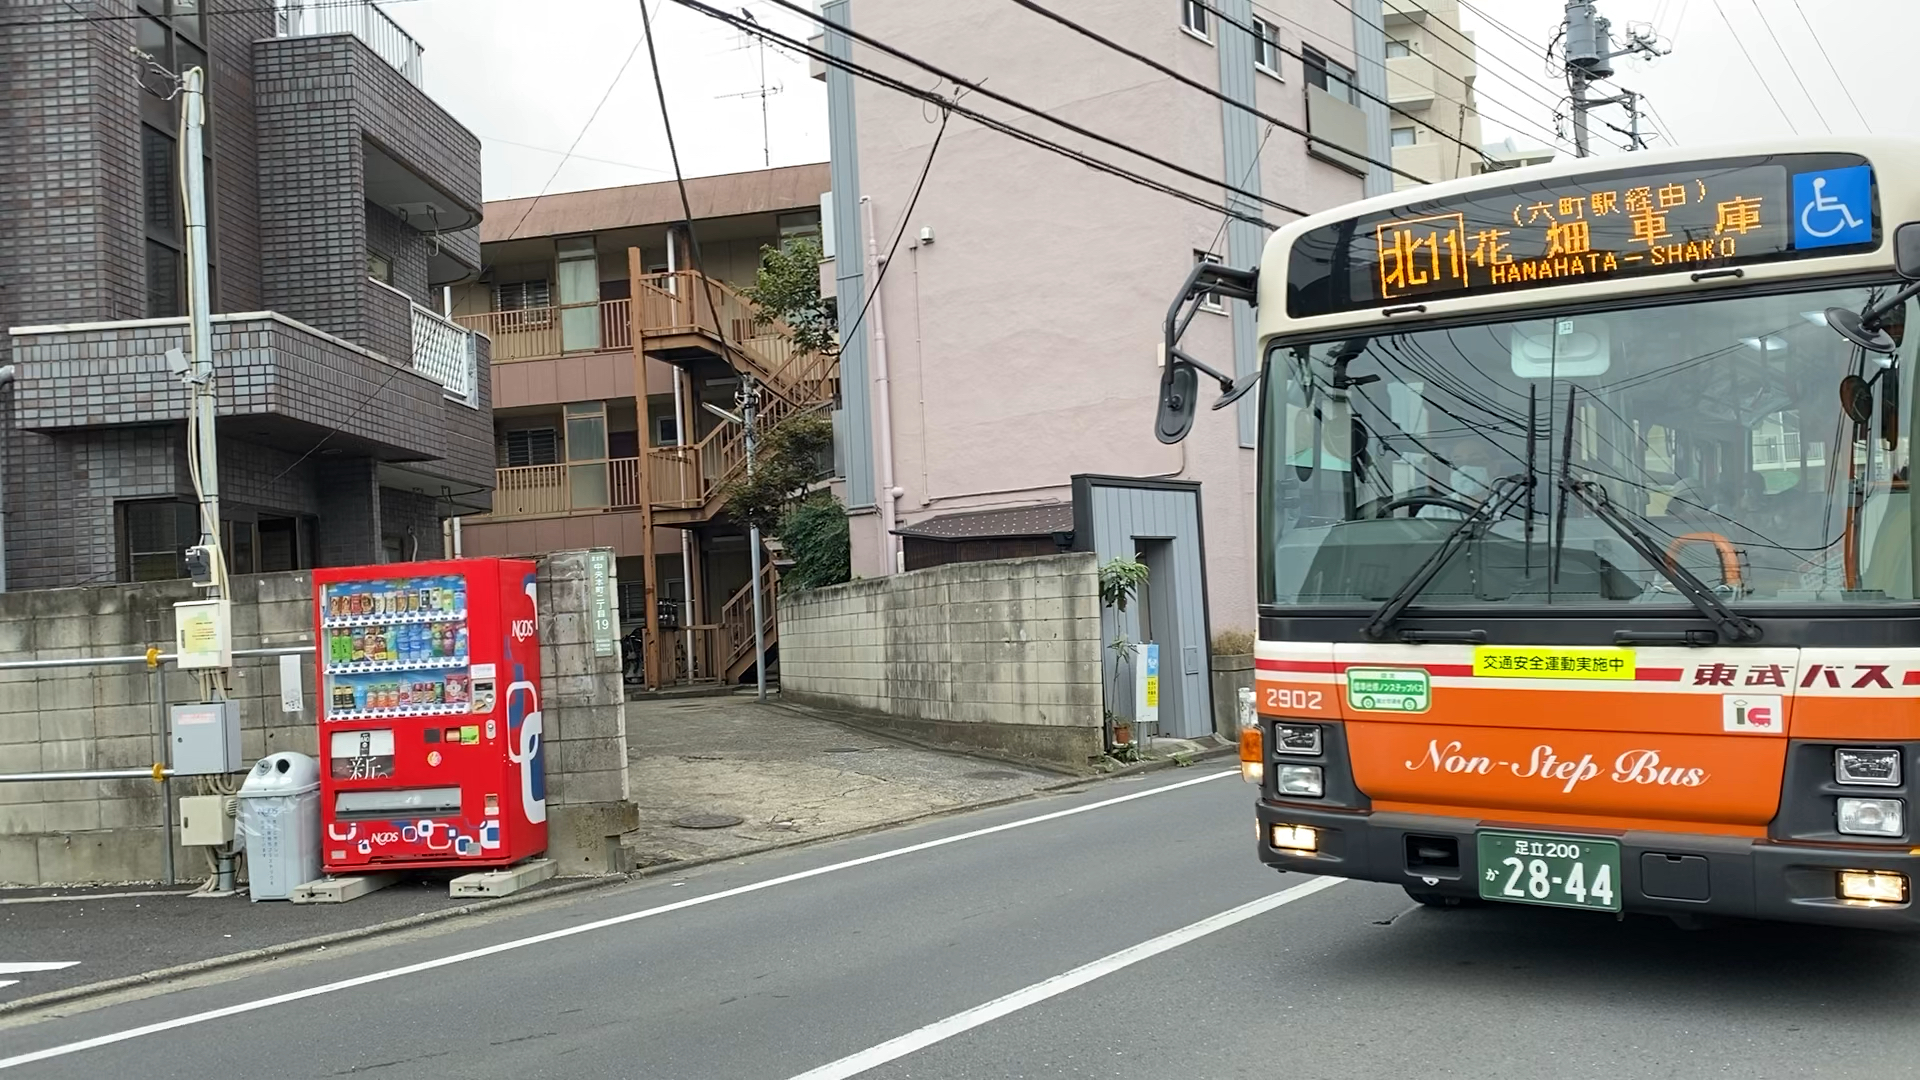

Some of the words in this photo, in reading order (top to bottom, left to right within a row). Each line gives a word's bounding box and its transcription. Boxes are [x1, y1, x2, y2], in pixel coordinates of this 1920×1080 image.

[1383, 227, 1460, 290] 北11
[595, 619, 609, 630] 19
[1483, 655, 1625, 673] 交通安全運動実施中
[1692, 663, 1894, 689] 東武バス
[1266, 688, 1323, 710] 2902
[1405, 739, 1605, 793] Non-Step
[1611, 749, 1711, 787] Bus
[1485, 868, 1499, 882] か
[1502, 857, 1613, 905] 28-44
